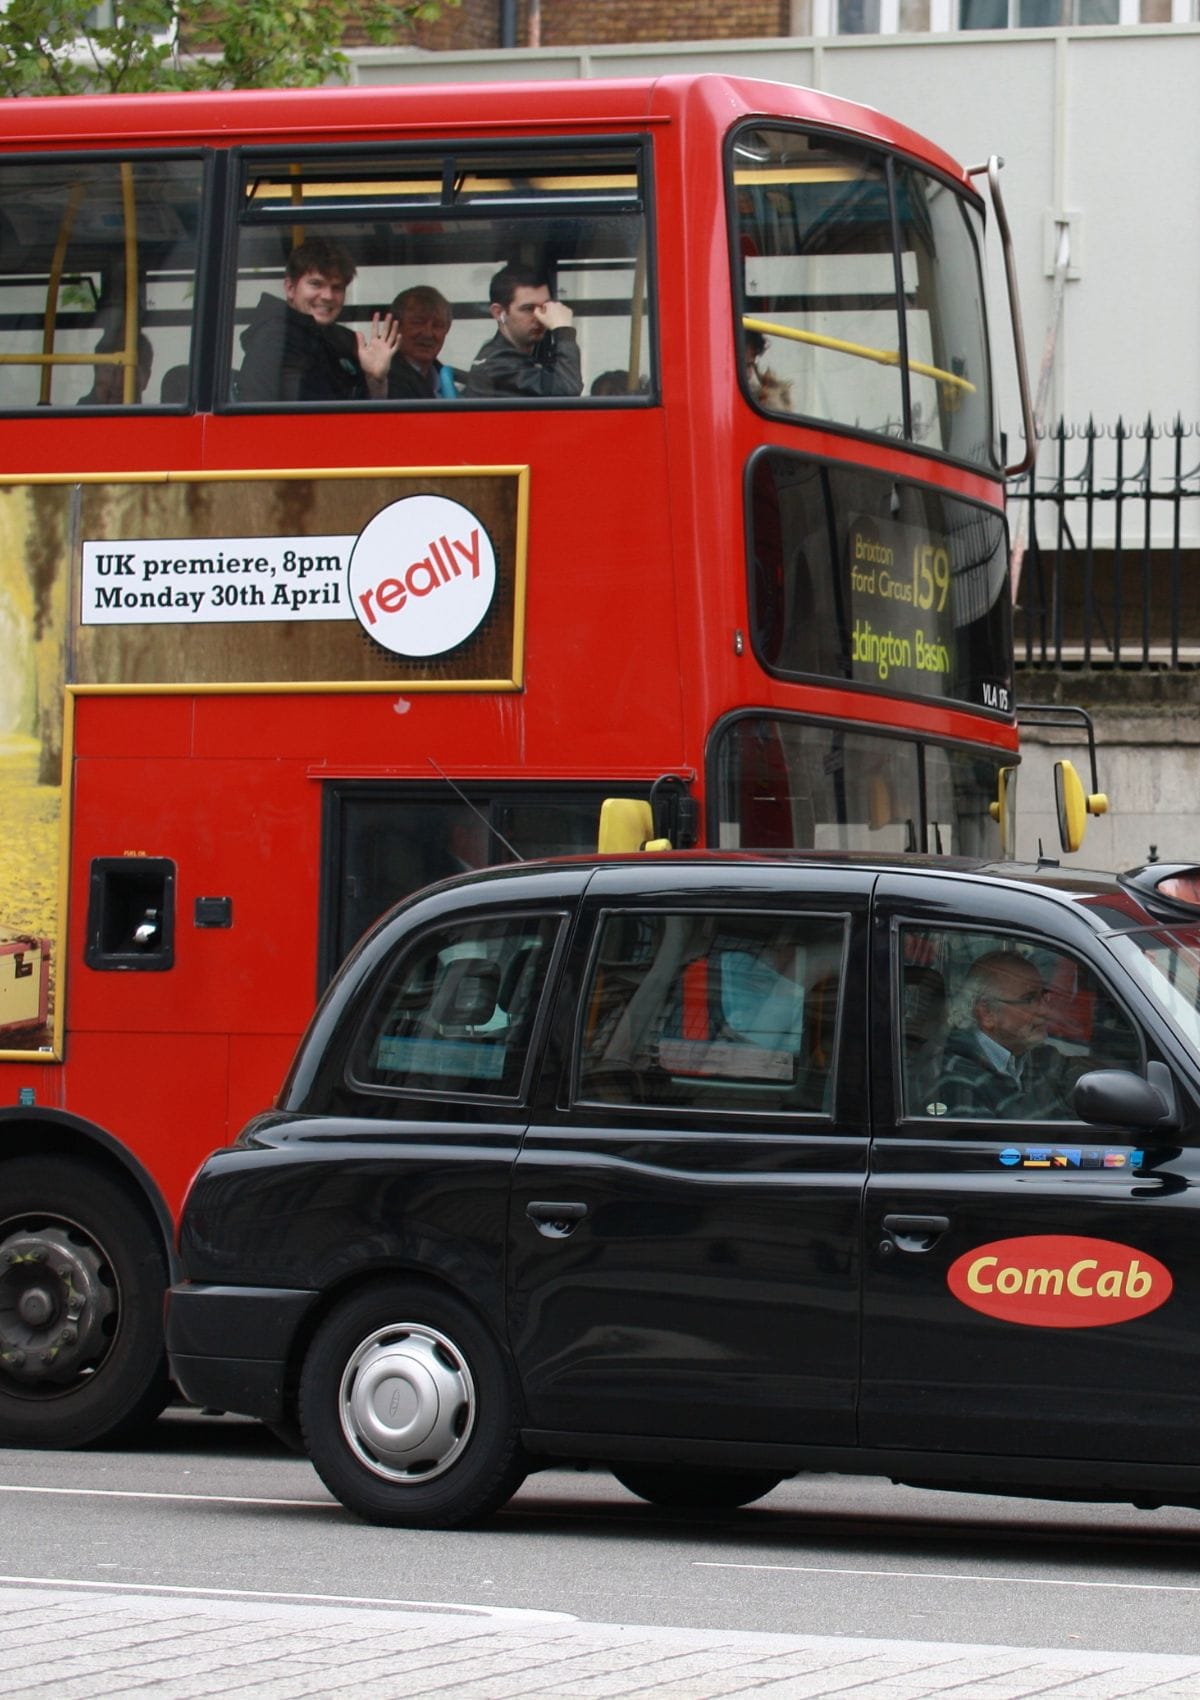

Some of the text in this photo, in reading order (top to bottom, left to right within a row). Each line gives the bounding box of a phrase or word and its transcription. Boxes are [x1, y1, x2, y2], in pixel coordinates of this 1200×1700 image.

[855, 533, 894, 565] Brixton
[96, 551, 342, 581] UK premiere, 8pm
[358, 528, 480, 625] really
[913, 543, 949, 612] 159
[95, 583, 341, 612] Monday 30th April
[878, 570, 913, 601] Circus
[915, 629, 950, 673] Basin
[982, 682, 998, 707] VLA
[967, 1256, 1153, 1299] ComCab
